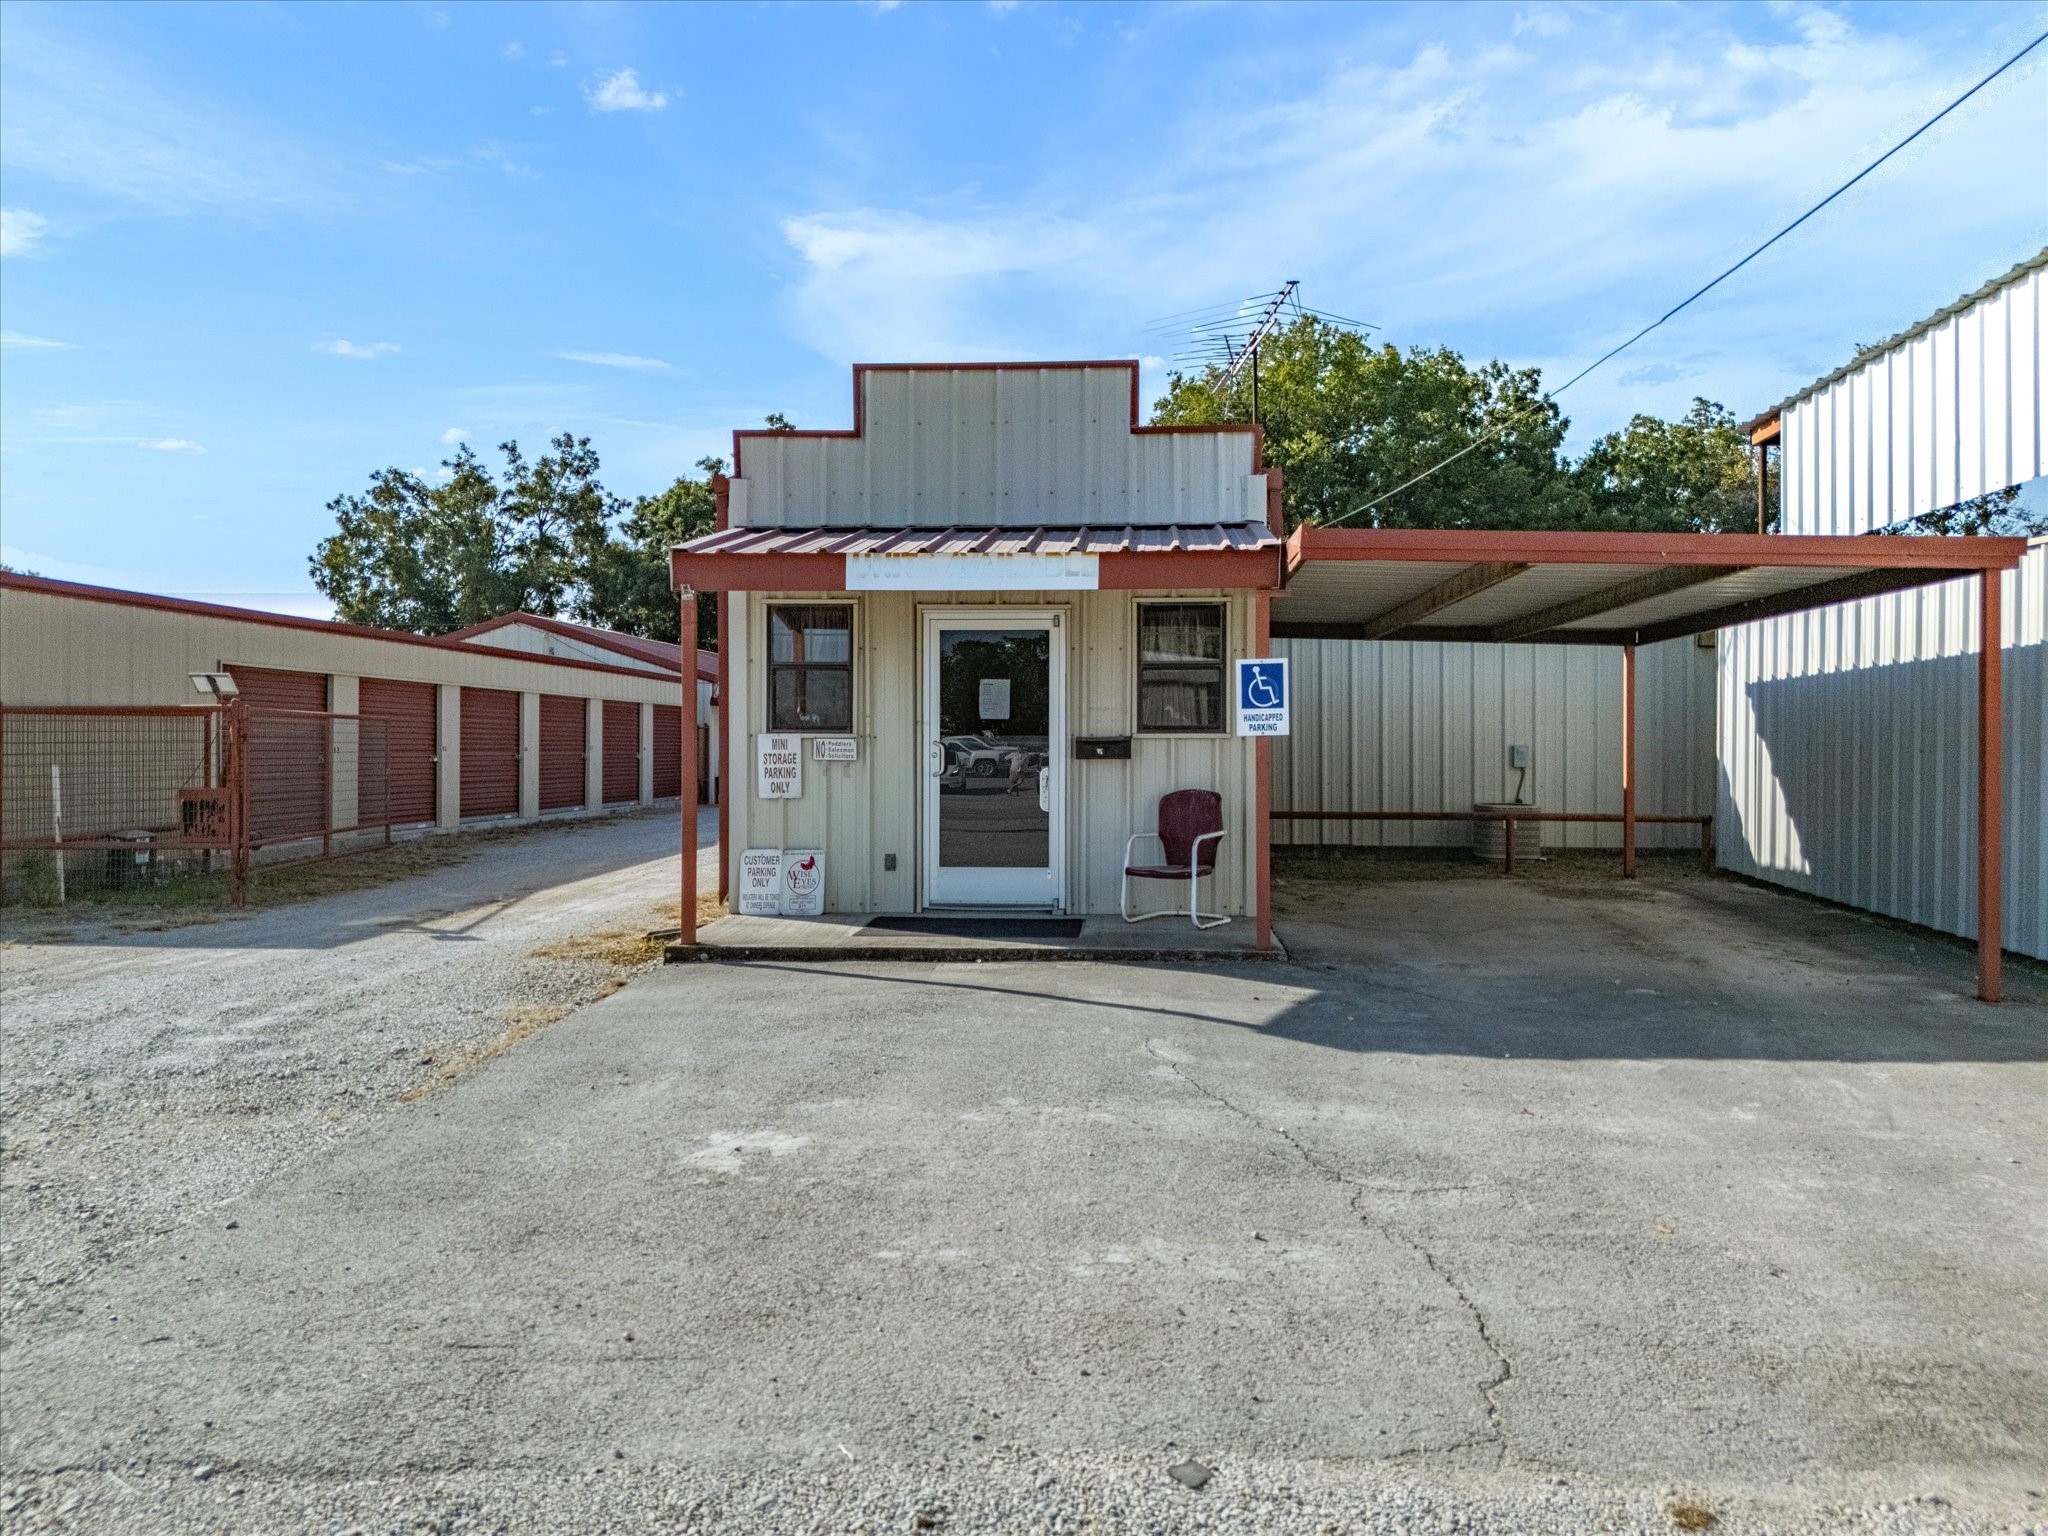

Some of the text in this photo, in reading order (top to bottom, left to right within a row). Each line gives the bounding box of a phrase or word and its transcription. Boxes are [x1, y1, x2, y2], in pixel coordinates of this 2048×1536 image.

[1243, 713, 1283, 722] HANDICAPPED
[1249, 723, 1277, 731] PARKING
[771, 738, 788, 750] MINI
[815, 741, 826, 758] NO
[763, 753, 797, 764] STORAGE
[764, 767, 797, 778] PARKING
[770, 782, 790, 793] ONLY
[744, 856, 780, 865] CUSTOMER
[748, 868, 776, 876] PARKING
[788, 870, 813, 880] WISE
[752, 878, 770, 888] ONLY
[793, 878, 817, 888] EYES
